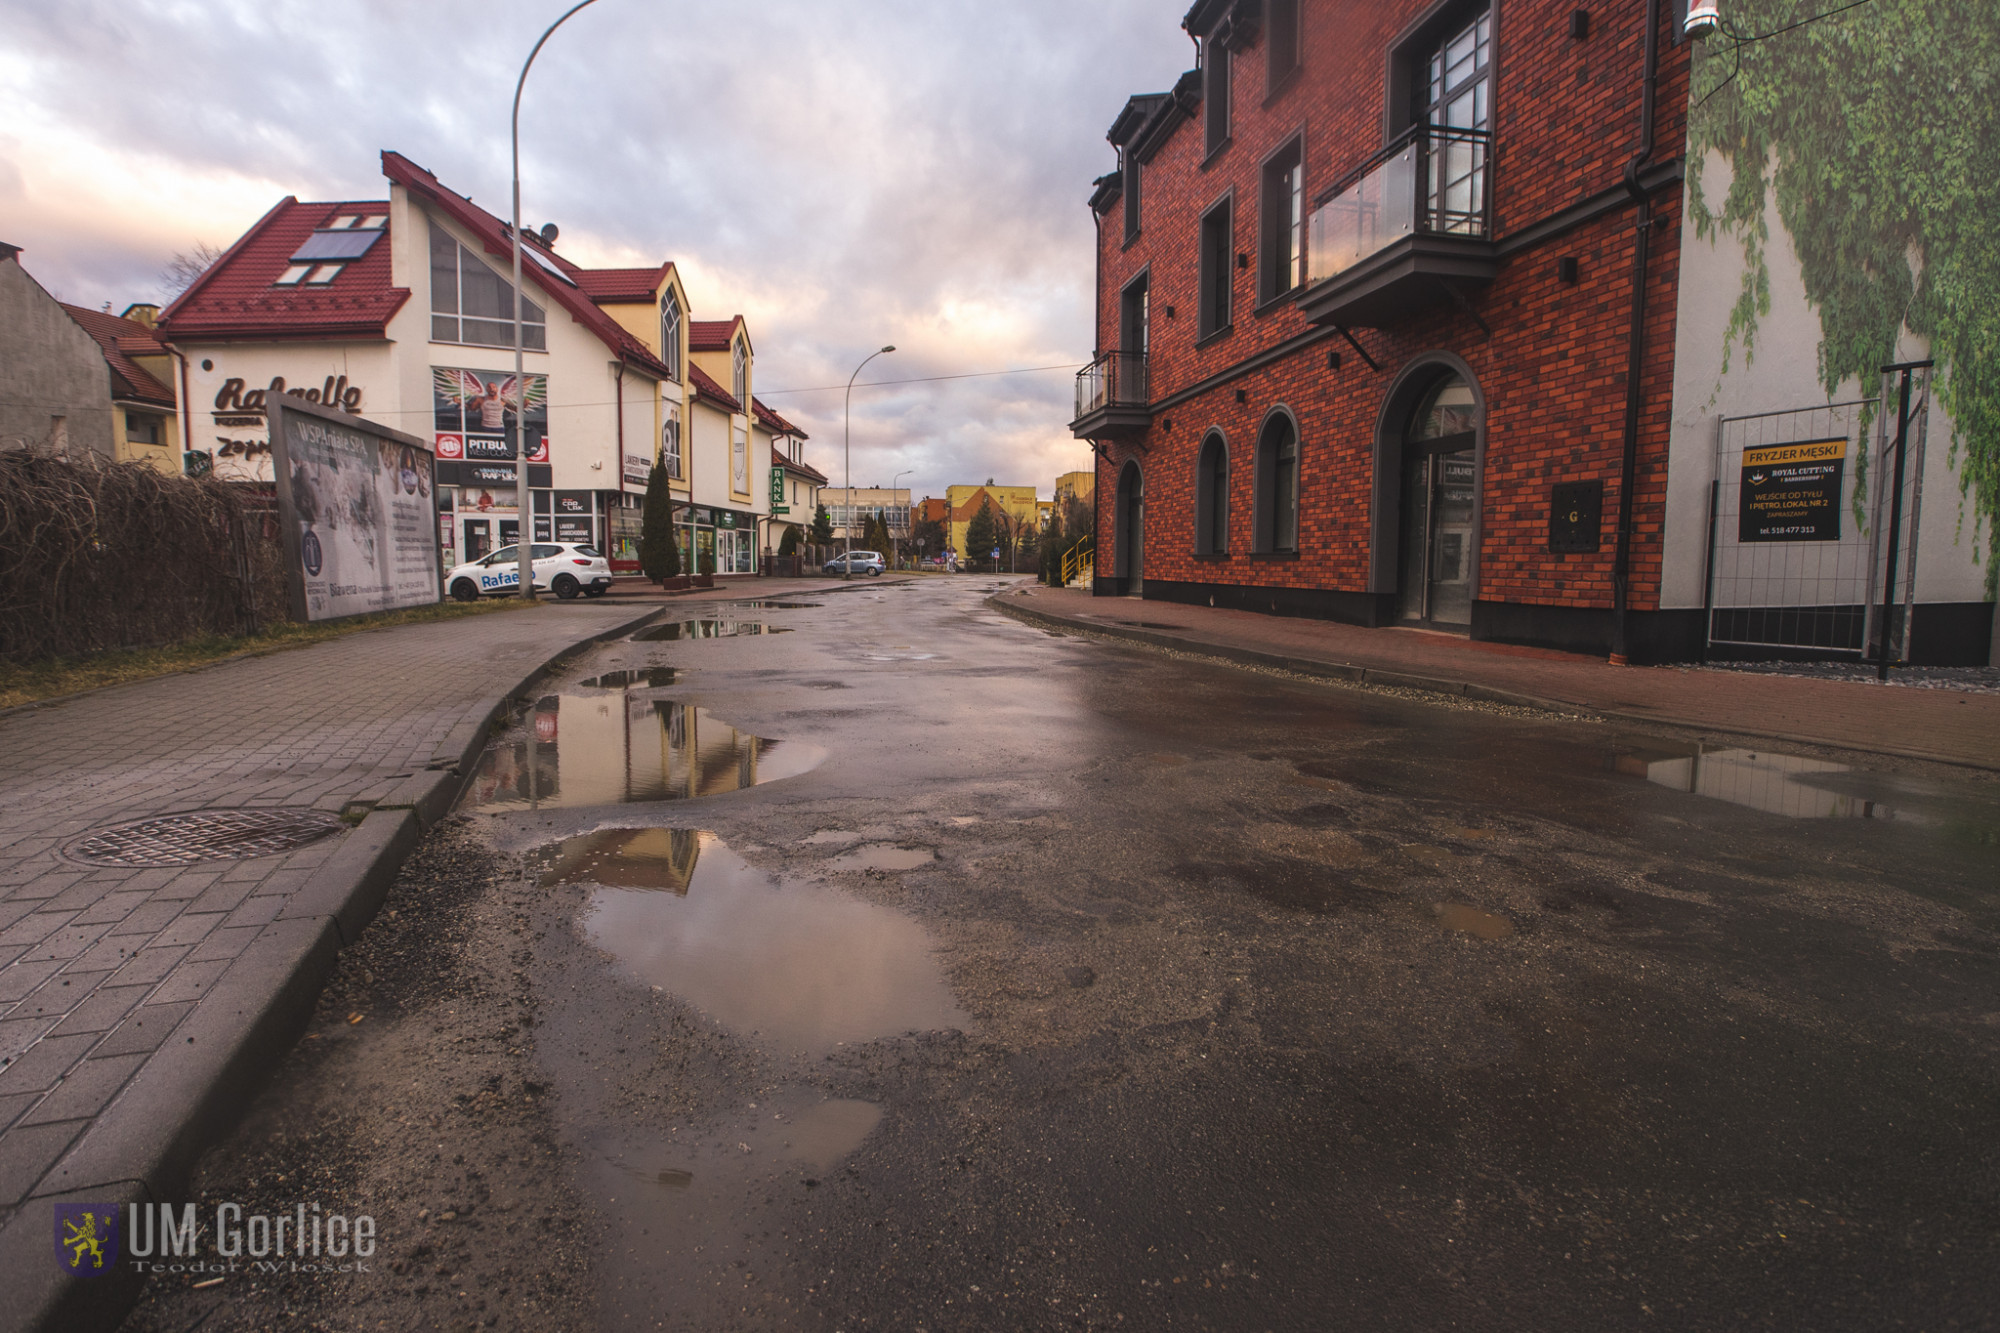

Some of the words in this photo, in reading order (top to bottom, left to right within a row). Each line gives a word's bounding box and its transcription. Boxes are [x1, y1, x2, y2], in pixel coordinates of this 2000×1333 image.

[215, 375, 361, 409] Rafaello
[350, 435, 369, 459] SPA
[468, 439, 507, 450] PITBU
[490, 449, 513, 457] COAS
[1749, 449, 1797, 463] FRYZJER
[1800, 445, 1838, 459] MĘSKI
[1772, 468, 1797, 477] ROYAL
[773, 470, 781, 501] BANK
[1788, 491, 1801, 499] OD
[1783, 500, 1809, 508] LOKAL
[1569, 511, 1578, 522] G
[1771, 526, 1785, 534] 518
[1800, 525, 1816, 533] 313
[481, 571, 536, 588] Rafaeo
